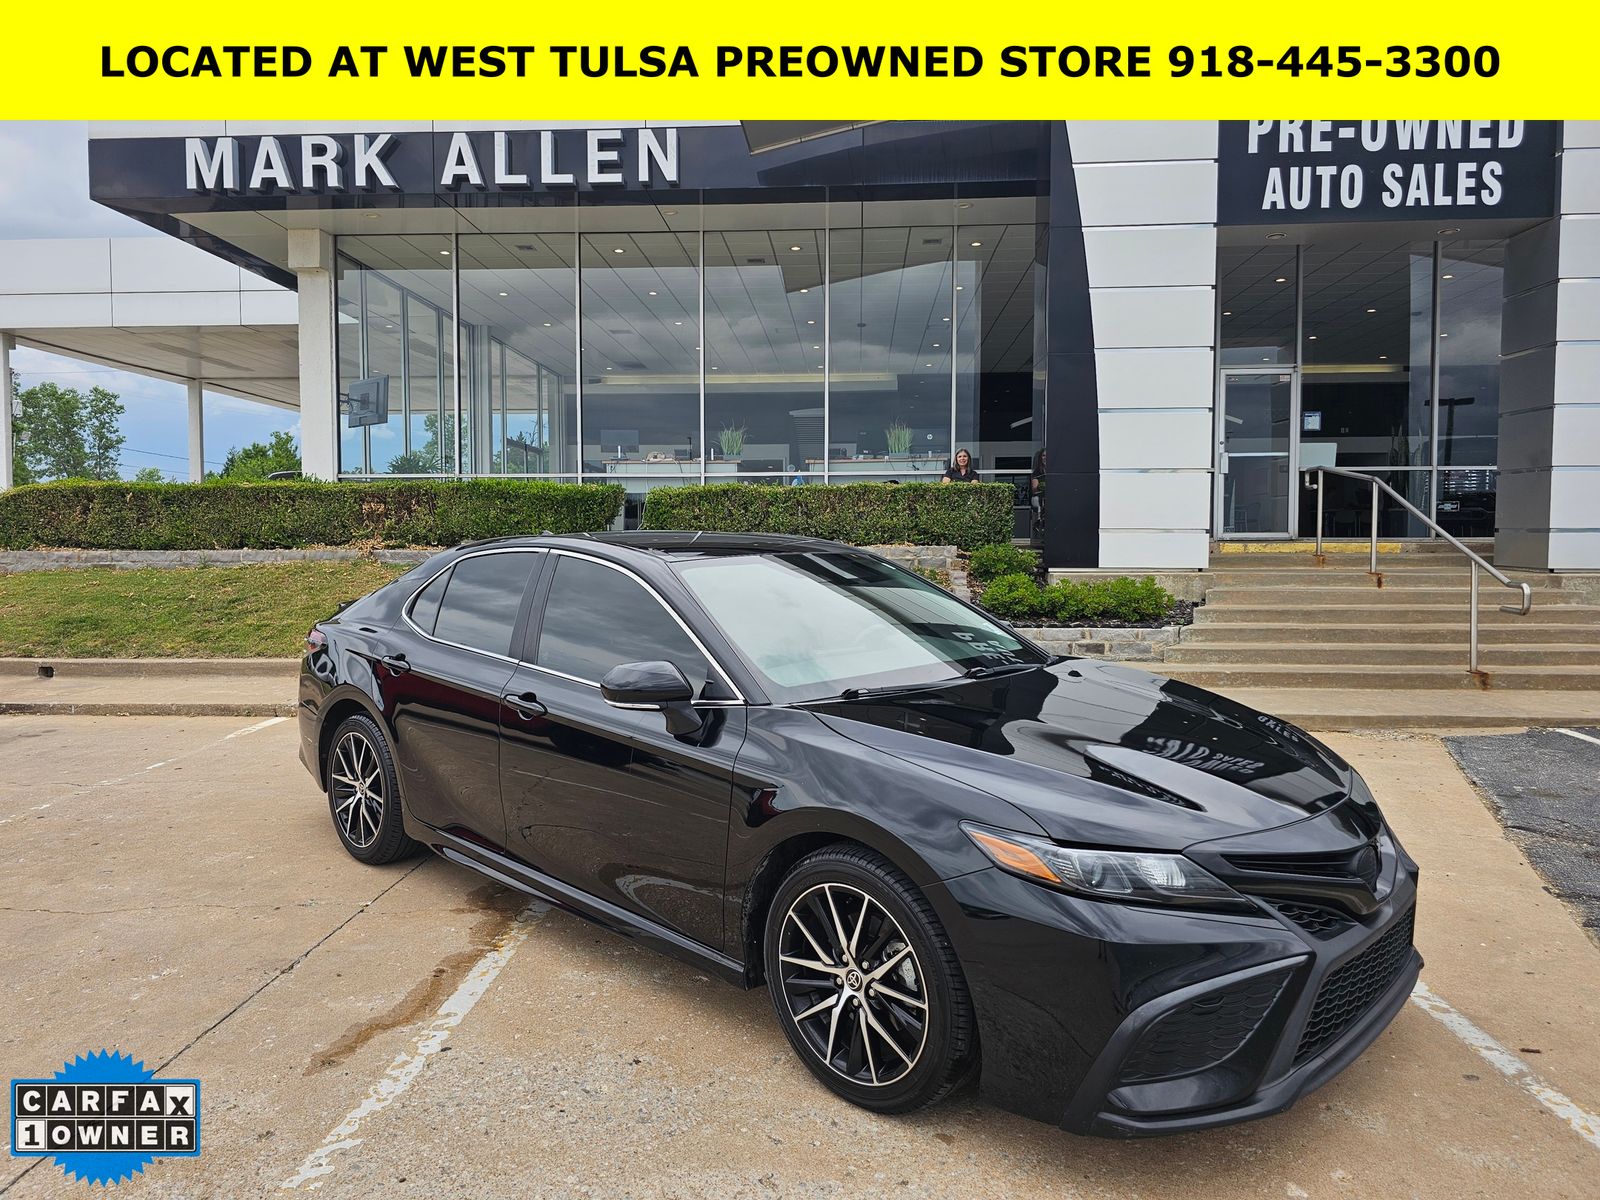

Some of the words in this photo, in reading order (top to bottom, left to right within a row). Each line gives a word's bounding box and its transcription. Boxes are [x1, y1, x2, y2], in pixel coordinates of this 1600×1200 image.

[185, 133, 399, 191] MARK
[440, 128, 679, 187] ALLEN
[1248, 120, 1525, 153] PRE-OWNED
[1262, 163, 1363, 210] AUTO
[1381, 161, 1502, 208] SALES
